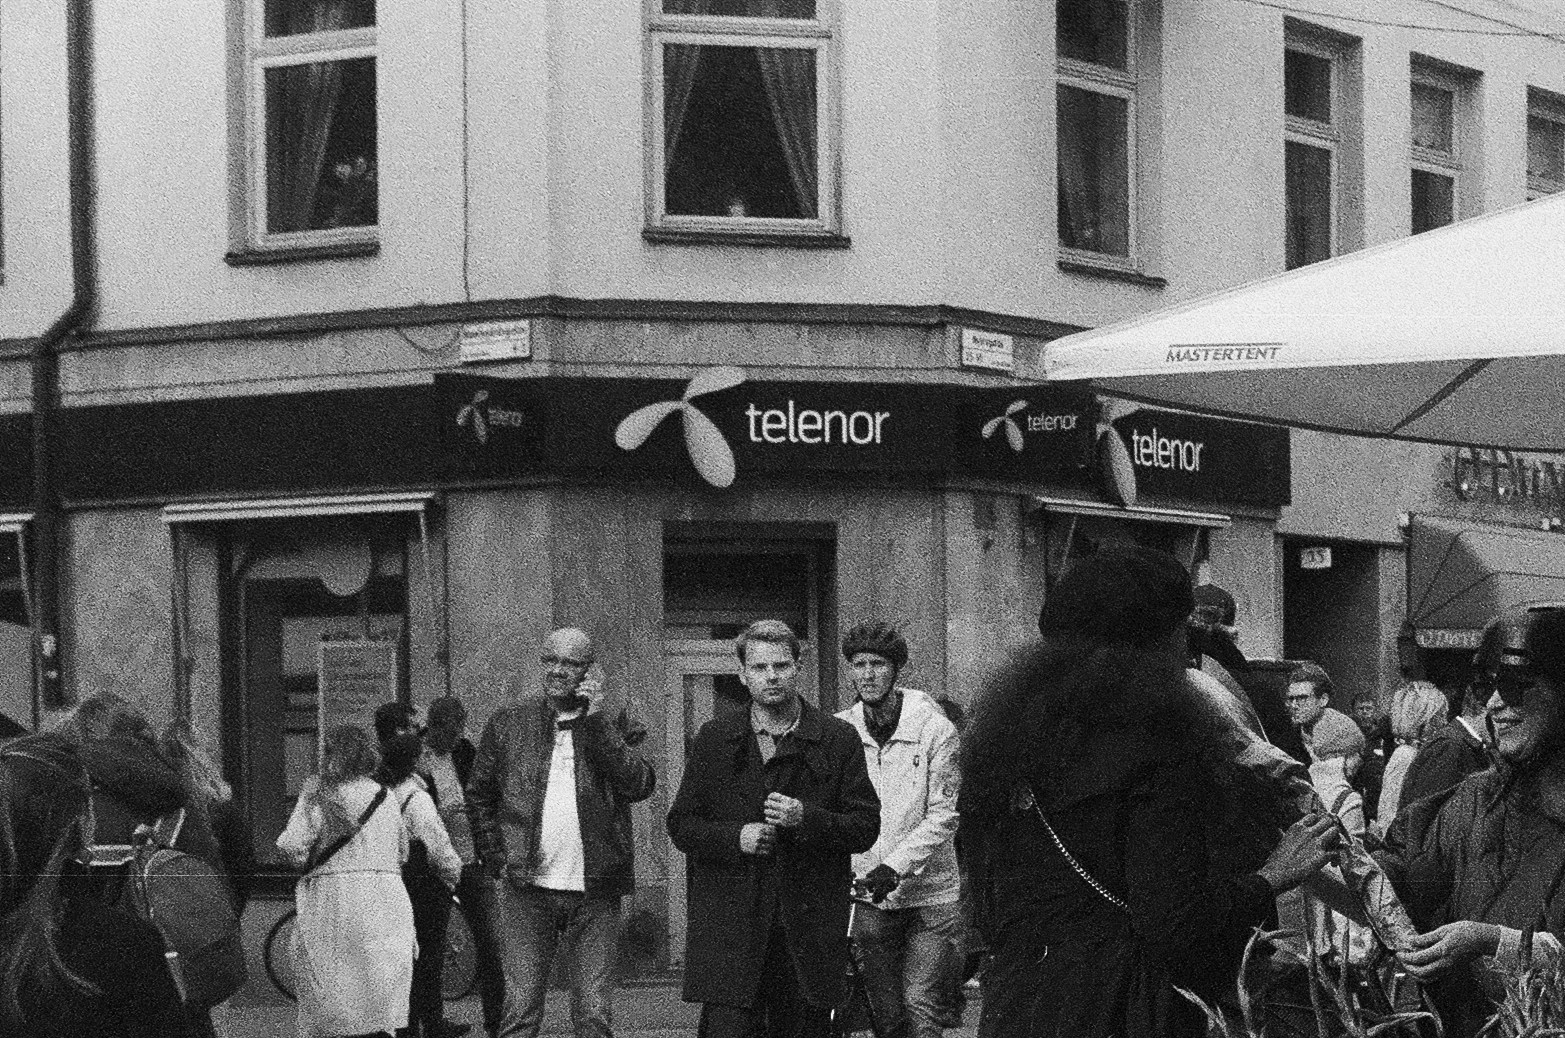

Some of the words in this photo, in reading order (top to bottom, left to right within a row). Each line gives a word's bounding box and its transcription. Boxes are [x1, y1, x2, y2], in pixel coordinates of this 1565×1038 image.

[1166, 347, 1281, 362] MASTERTENT
[746, 401, 890, 444] telenor
[1028, 410, 1078, 432] telenor
[1132, 427, 1203, 471] telenor
